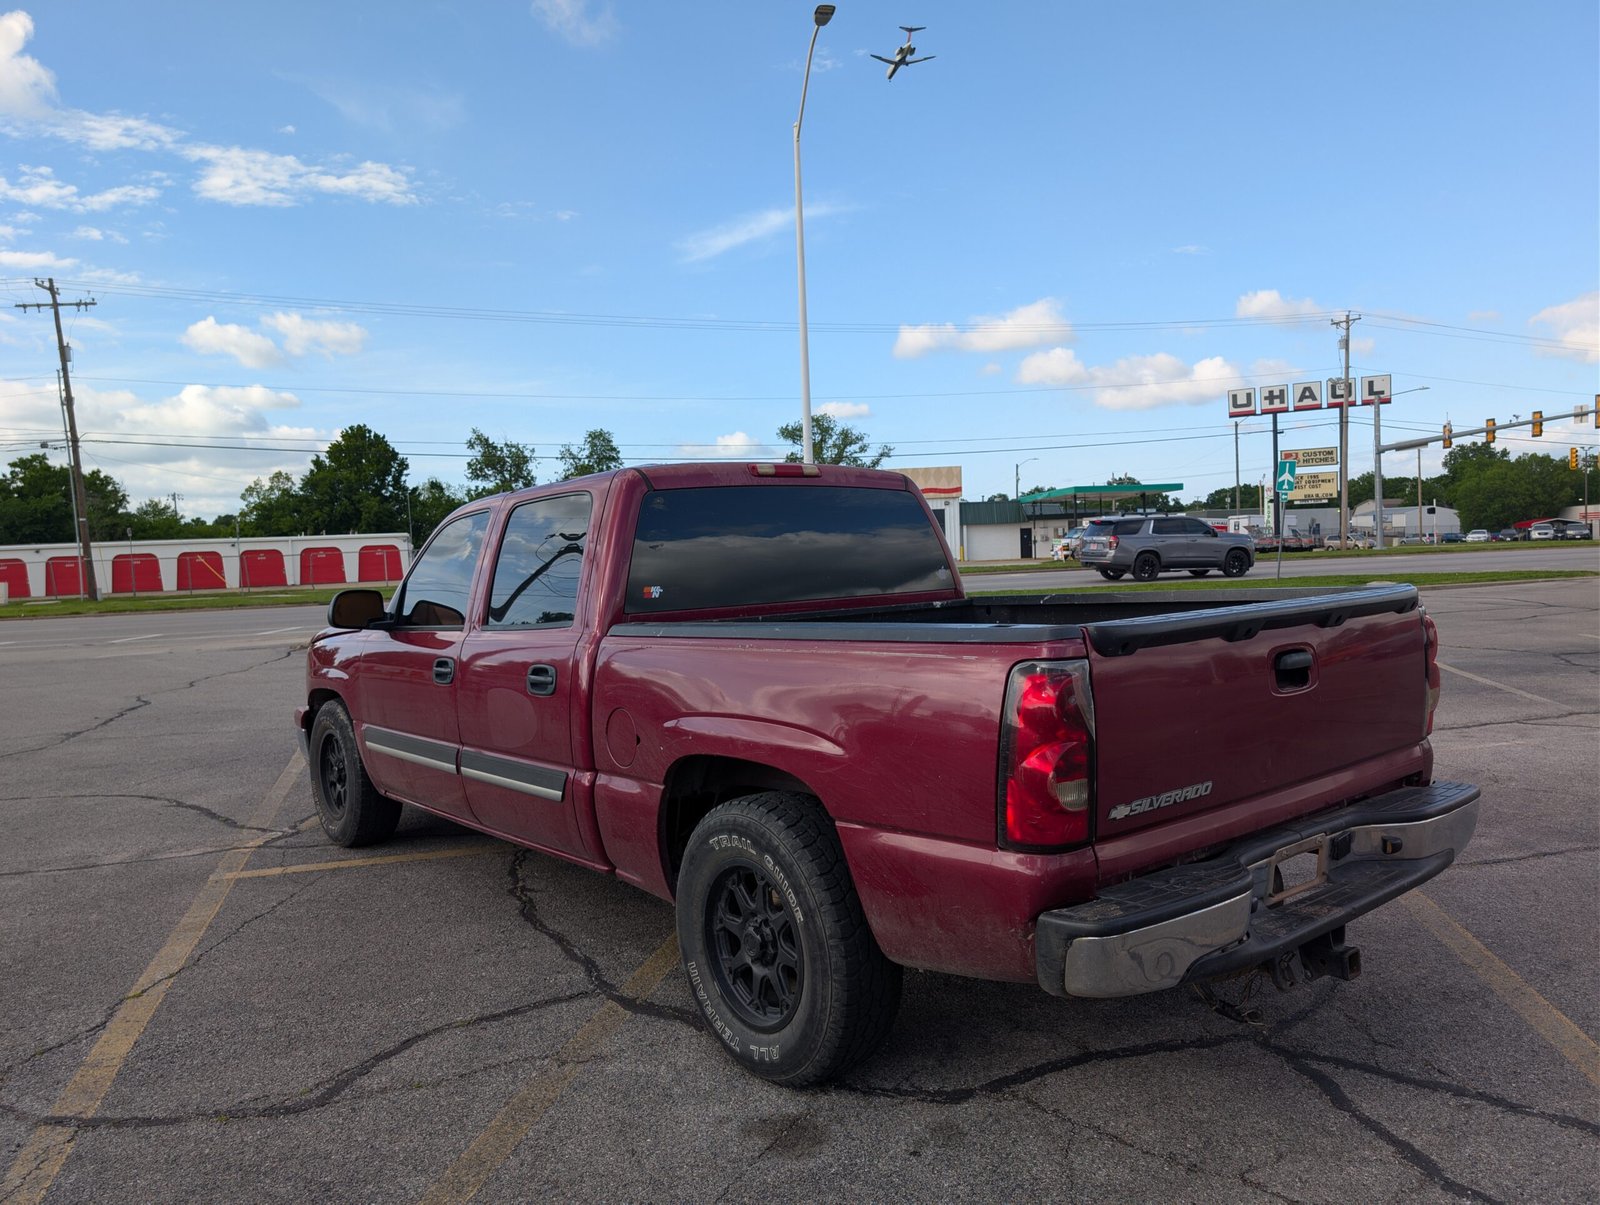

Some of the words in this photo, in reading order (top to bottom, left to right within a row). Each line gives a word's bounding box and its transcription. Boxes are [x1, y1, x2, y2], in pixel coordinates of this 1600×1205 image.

[1231, 380, 1385, 409] UHAUL
[1302, 450, 1334, 458] CUSTOM
[1129, 781, 1213, 815] SILVERADO
[709, 835, 757, 855] TRAIL
[764, 854, 804, 924] GUIDE
[687, 961, 740, 1053] TERRAIN
[749, 1044, 780, 1061] ALL
